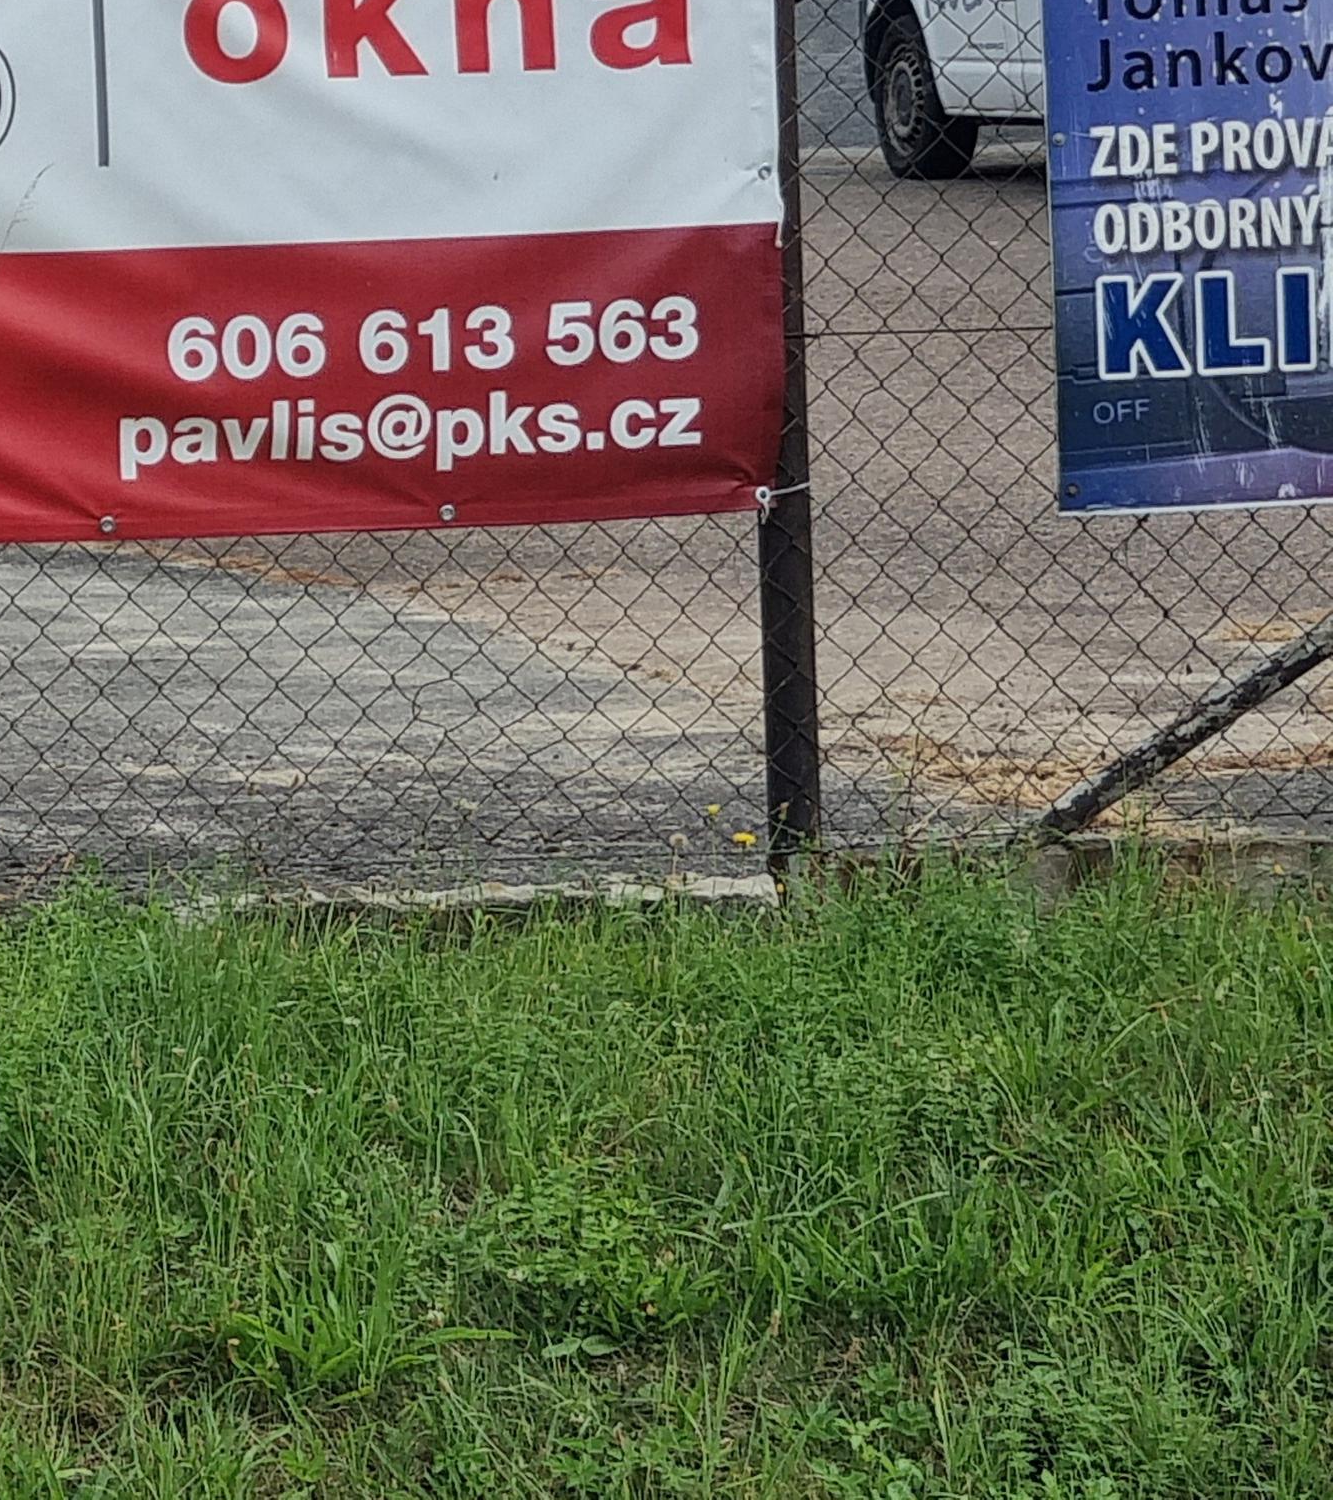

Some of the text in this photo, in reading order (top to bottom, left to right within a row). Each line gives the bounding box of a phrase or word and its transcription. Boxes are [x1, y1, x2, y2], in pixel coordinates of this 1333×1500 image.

[1086, 31, 1333, 93] Jankov
[1089, 123, 1179, 177] ZDE
[1094, 184, 1321, 254] ODBORNÝ
[167, 296, 700, 383] 606 613 563
[119, 390, 702, 480] pavlis@pks.cz
[1093, 398, 1150, 424] OFF
